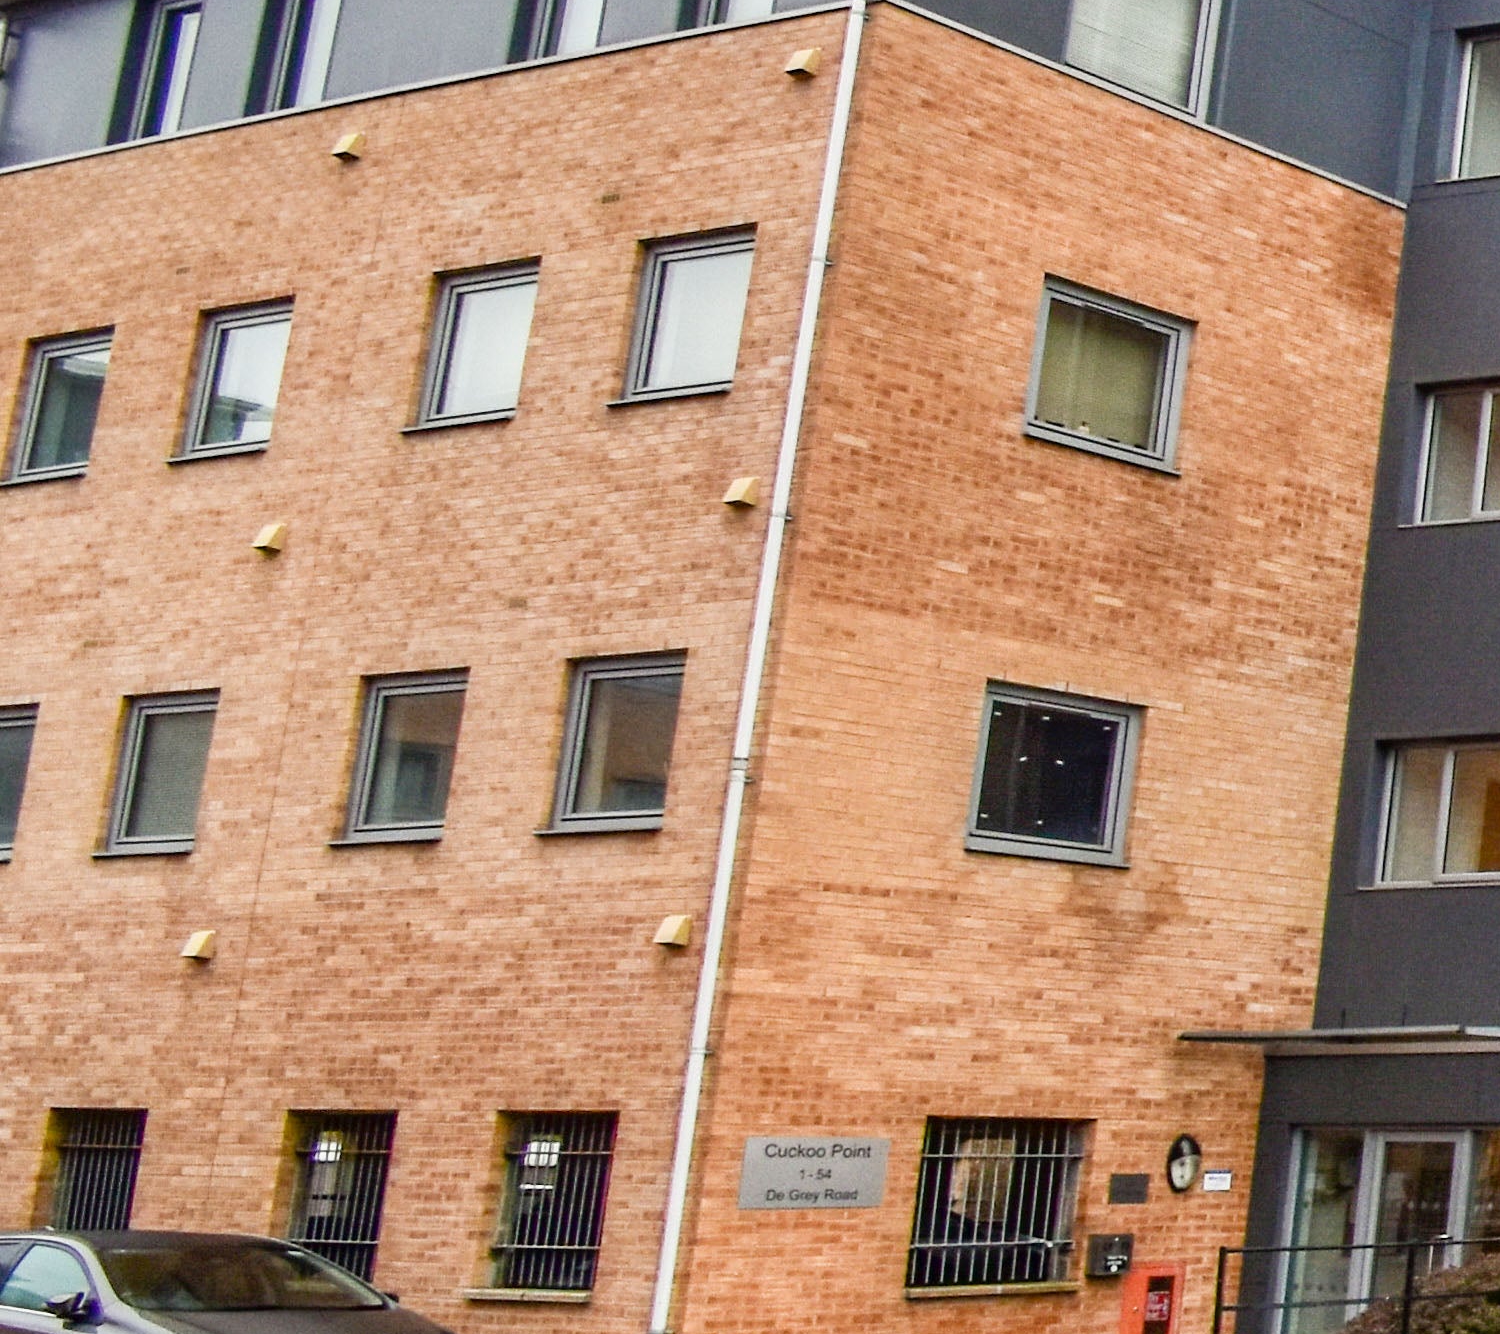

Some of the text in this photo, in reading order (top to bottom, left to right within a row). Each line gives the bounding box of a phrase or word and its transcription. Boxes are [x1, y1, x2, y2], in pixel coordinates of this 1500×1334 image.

[764, 1143, 872, 1158] Cuckoo Point
[815, 1168, 832, 1180] 54
[765, 1189, 859, 1203] De Grey Road
